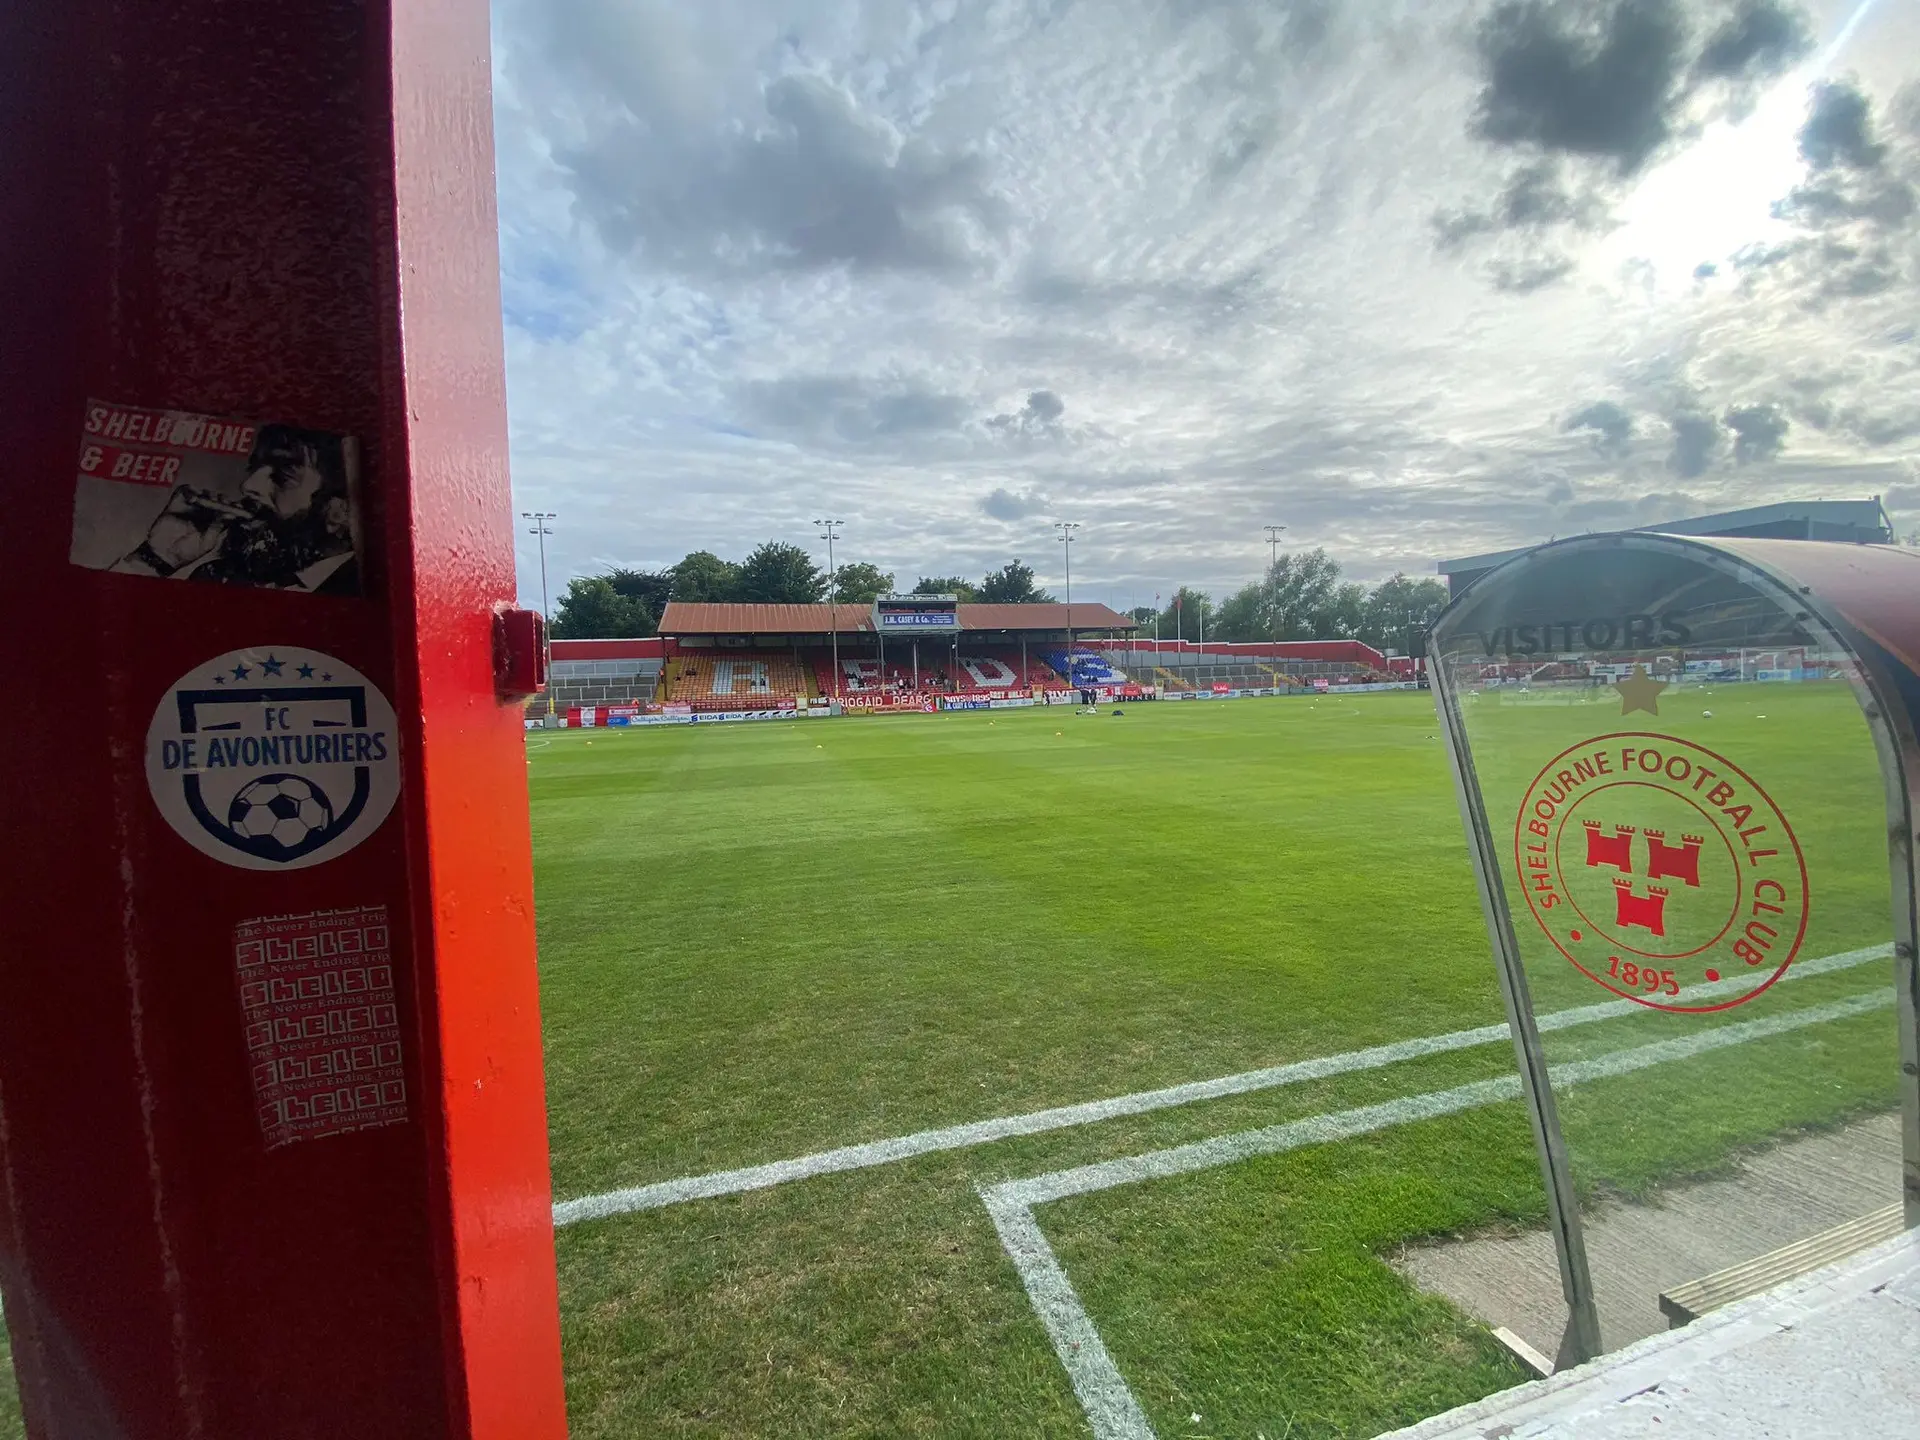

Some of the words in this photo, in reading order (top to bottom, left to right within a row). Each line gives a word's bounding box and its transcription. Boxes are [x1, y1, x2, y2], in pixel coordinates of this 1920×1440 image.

[85, 408, 255, 452] SHELBOURNE
[80, 446, 104, 472] &
[111, 452, 180, 483] BEER
[898, 615, 914, 624] CASEY
[915, 615, 920, 624] &
[1479, 610, 1691, 656] VISITORS
[265, 706, 291, 731] FC
[893, 695, 932, 705] DEARG
[162, 739, 197, 770] DE
[206, 732, 388, 769] AVONTURIERS
[1527, 751, 1613, 910] SHELBOURNE
[1621, 748, 1779, 867] FOOTBALL
[1732, 879, 1786, 966] CLUB
[1604, 955, 1681, 997] 1895
